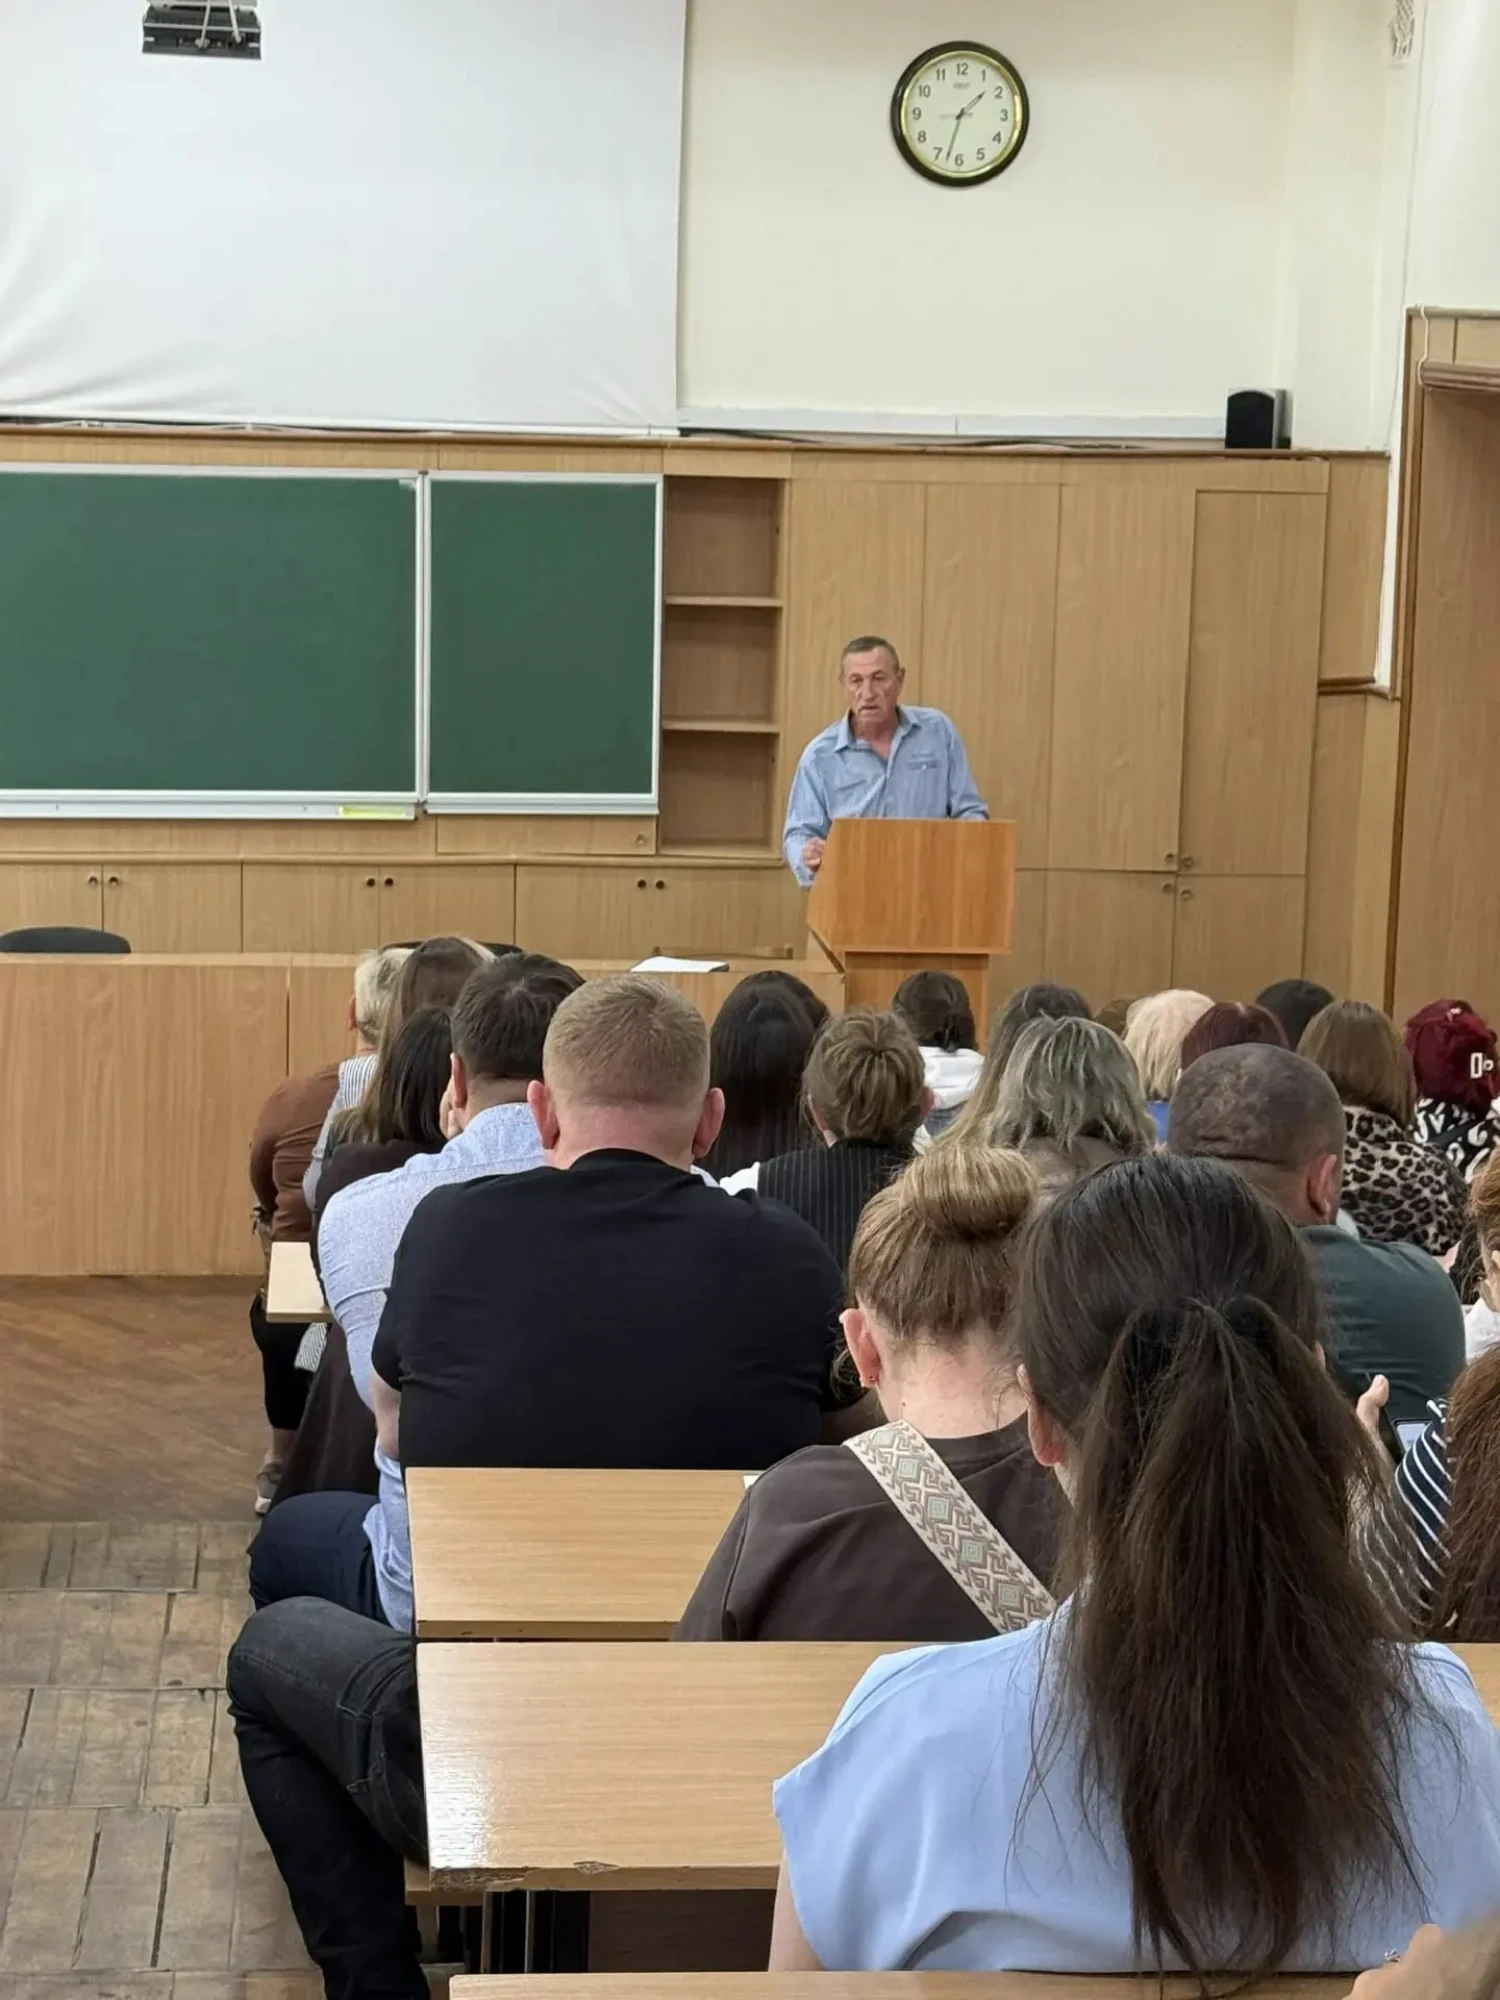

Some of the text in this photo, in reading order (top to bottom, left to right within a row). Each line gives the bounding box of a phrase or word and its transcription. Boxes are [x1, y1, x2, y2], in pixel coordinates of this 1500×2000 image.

[936, 69, 946, 81] 11
[956, 62, 969, 76] 12
[981, 69, 986, 81] 1
[919, 85, 931, 98] 10
[994, 86, 1003, 99] 2
[912, 107, 921, 120] 9
[1000, 109, 1008, 121] 3
[917, 130, 927, 143] 8
[992, 131, 1001, 144] 4
[933, 147, 943, 160] 7
[954, 153, 964, 166] 6
[976, 148, 985, 160] 5
